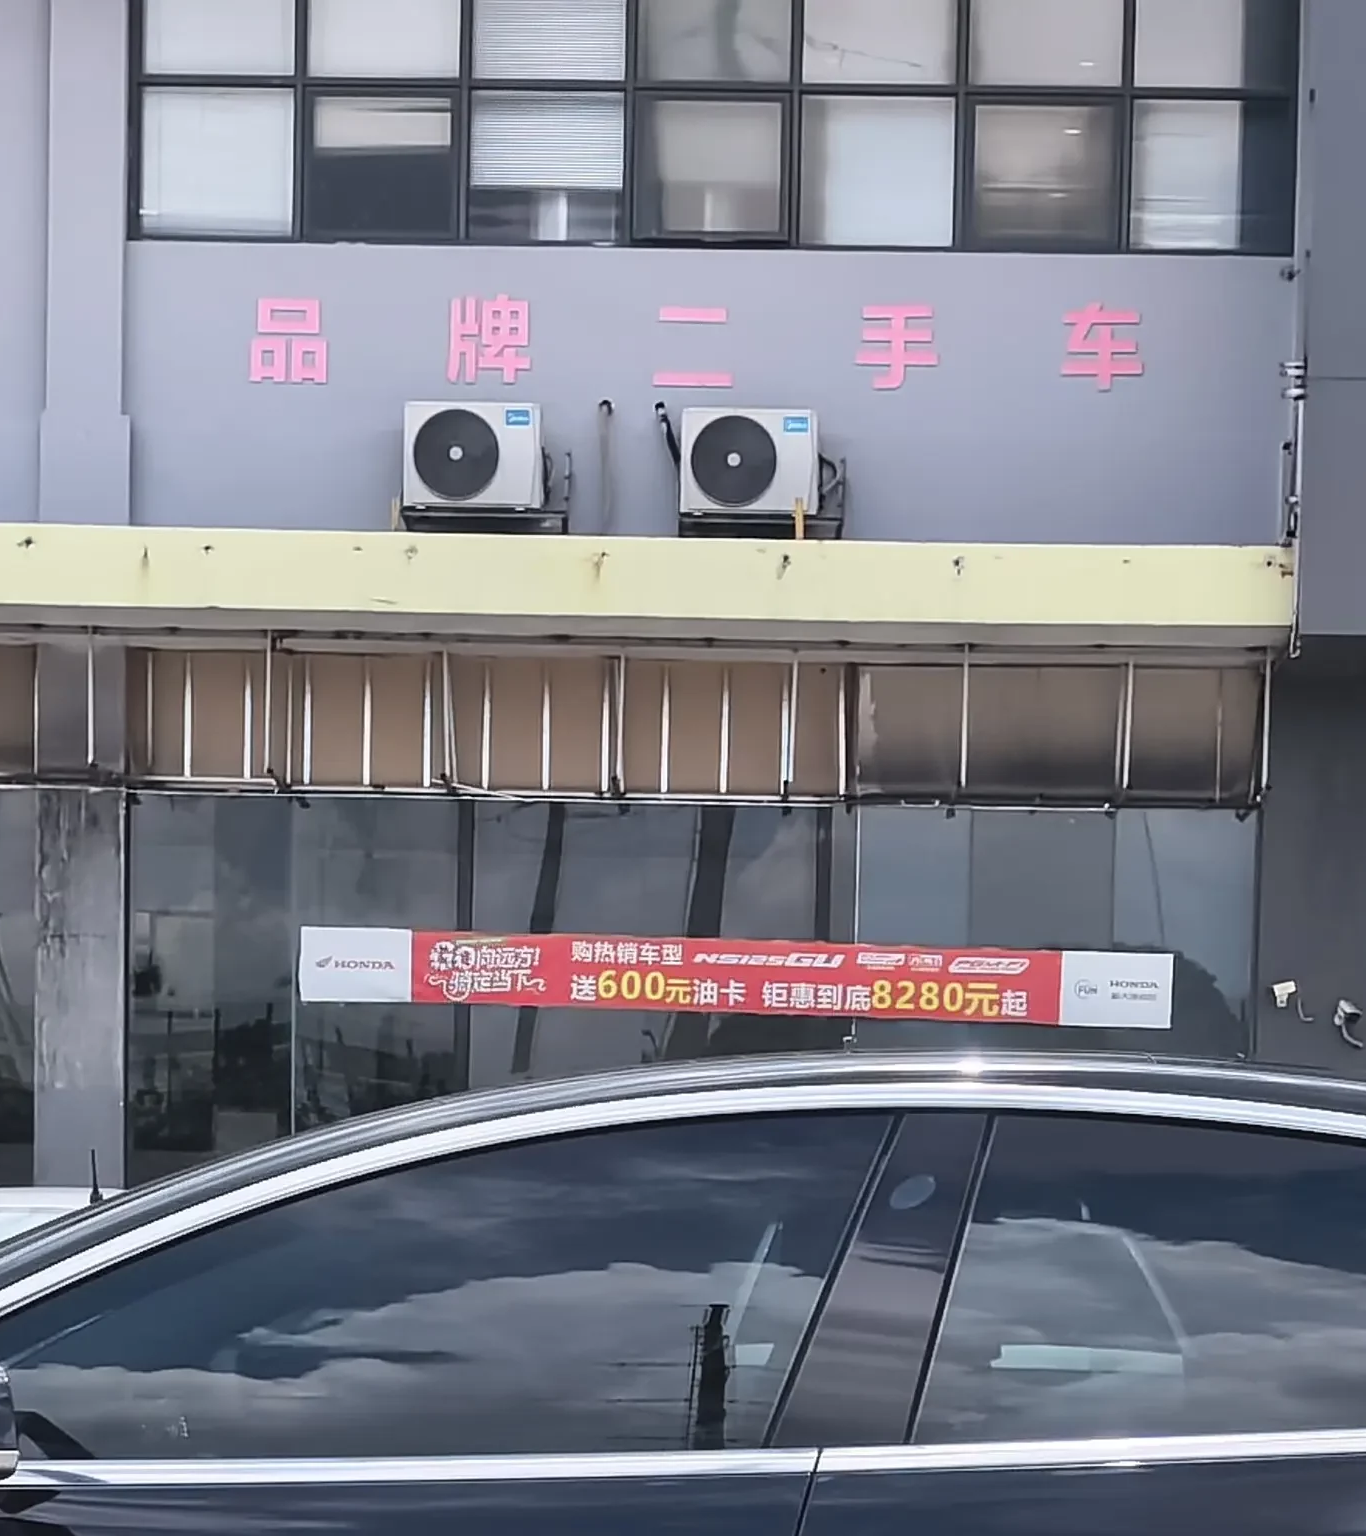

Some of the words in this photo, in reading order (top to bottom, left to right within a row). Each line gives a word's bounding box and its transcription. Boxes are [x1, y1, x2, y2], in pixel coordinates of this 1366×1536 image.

[248, 293, 1144, 391] 品牌二手车
[571, 940, 683, 965] 购热销车型
[334, 960, 395, 971] HONDA
[570, 969, 747, 1006] 送600元油卡
[762, 979, 1028, 1017] 钜惠到底8280元起
[1110, 980, 1159, 989] HONDA
